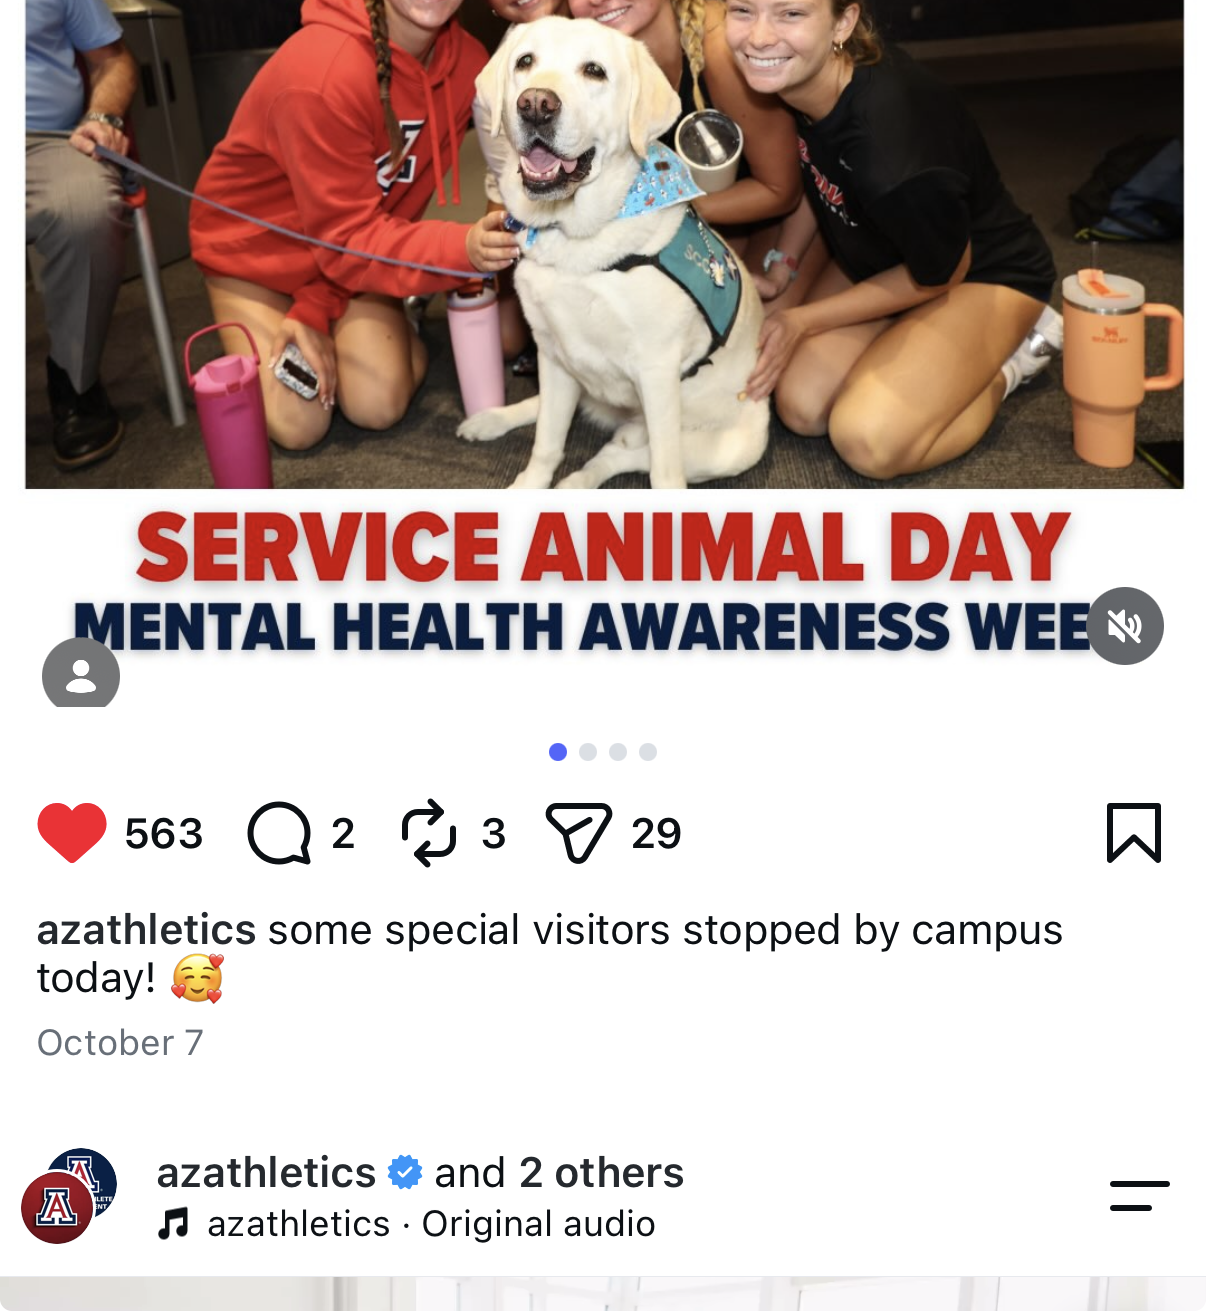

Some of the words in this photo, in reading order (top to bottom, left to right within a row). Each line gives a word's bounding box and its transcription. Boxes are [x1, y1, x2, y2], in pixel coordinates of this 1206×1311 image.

[126, 818, 202, 849] 563
[333, 818, 354, 848] 2
[483, 818, 505, 849] 3
[633, 818, 680, 849] 29
[38, 912, 255, 944] azathletics
[269, 921, 371, 944] some
[386, 913, 517, 951] special
[534, 913, 669, 944] visitors
[684, 913, 838, 951] stopped
[856, 913, 899, 952] by
[913, 921, 1062, 951] campus
[37, 961, 153, 1000] today!
[38, 1028, 174, 1056] October
[186, 1030, 203, 1055] 7
[158, 1155, 375, 1187] azathletics
[436, 1156, 503, 1187] and
[521, 1157, 542, 1187] 2
[556, 1156, 683, 1187] others
[209, 1209, 389, 1236] azathletics
[423, 1209, 550, 1243] Original
[565, 1209, 654, 1236] audio
